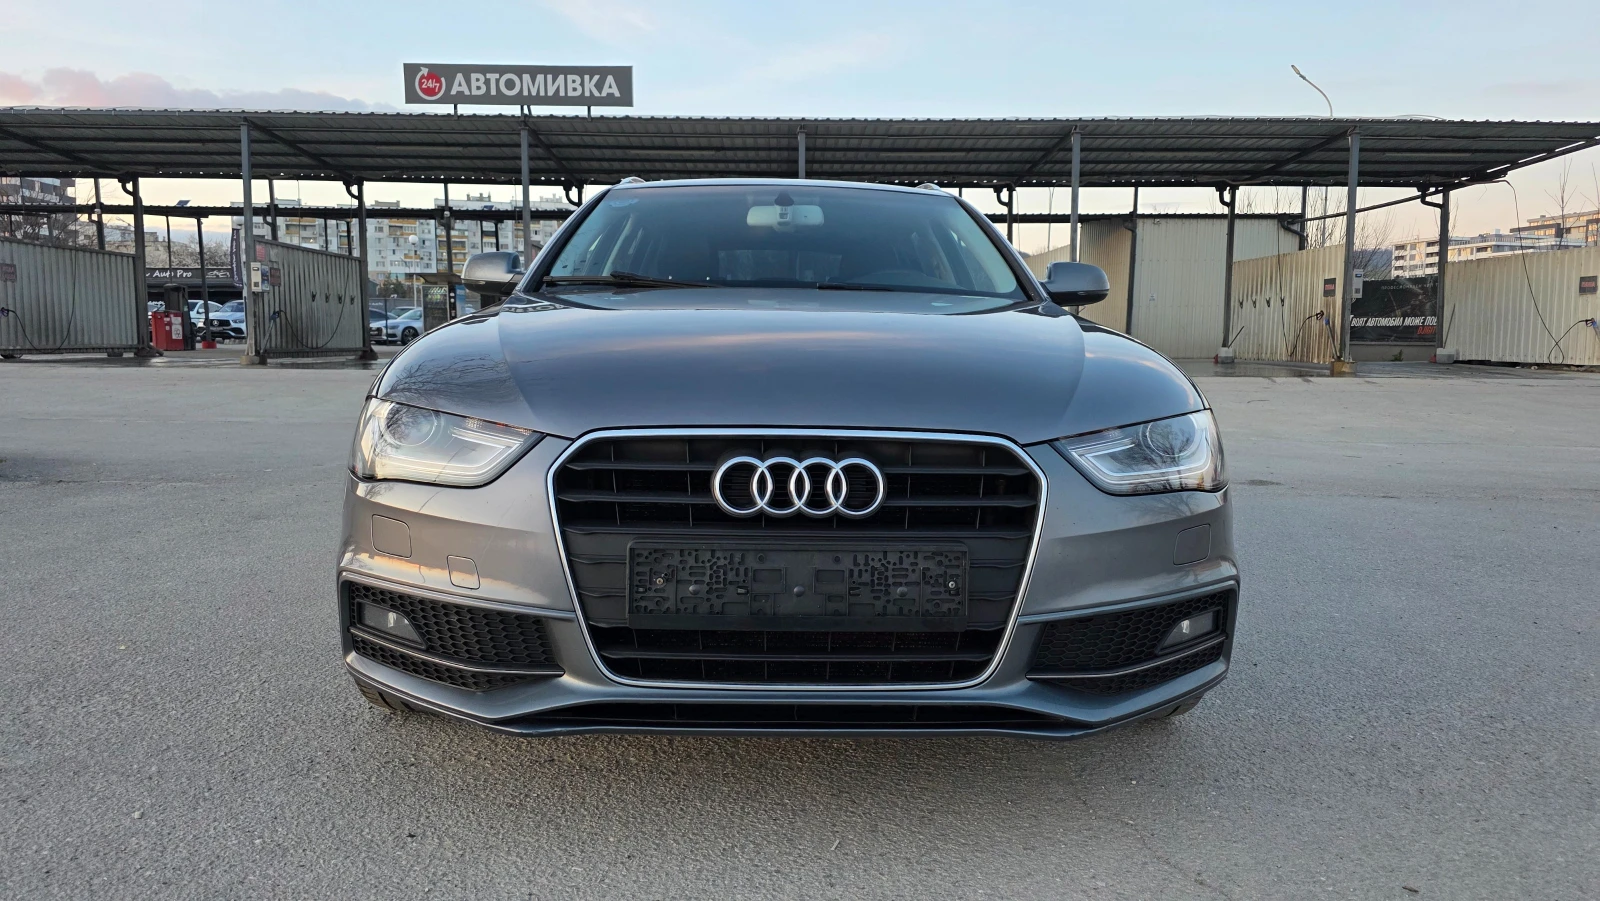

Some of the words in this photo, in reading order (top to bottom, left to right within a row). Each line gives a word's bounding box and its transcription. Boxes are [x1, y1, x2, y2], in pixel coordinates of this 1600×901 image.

[421, 78, 440, 93] 24/7
[450, 72, 621, 98] АВТОМИВКА
[176, 269, 193, 278] Pro
[1366, 317, 1403, 327] АВТОМОБИЛ
[1403, 316, 1425, 326] МОЖЕ
